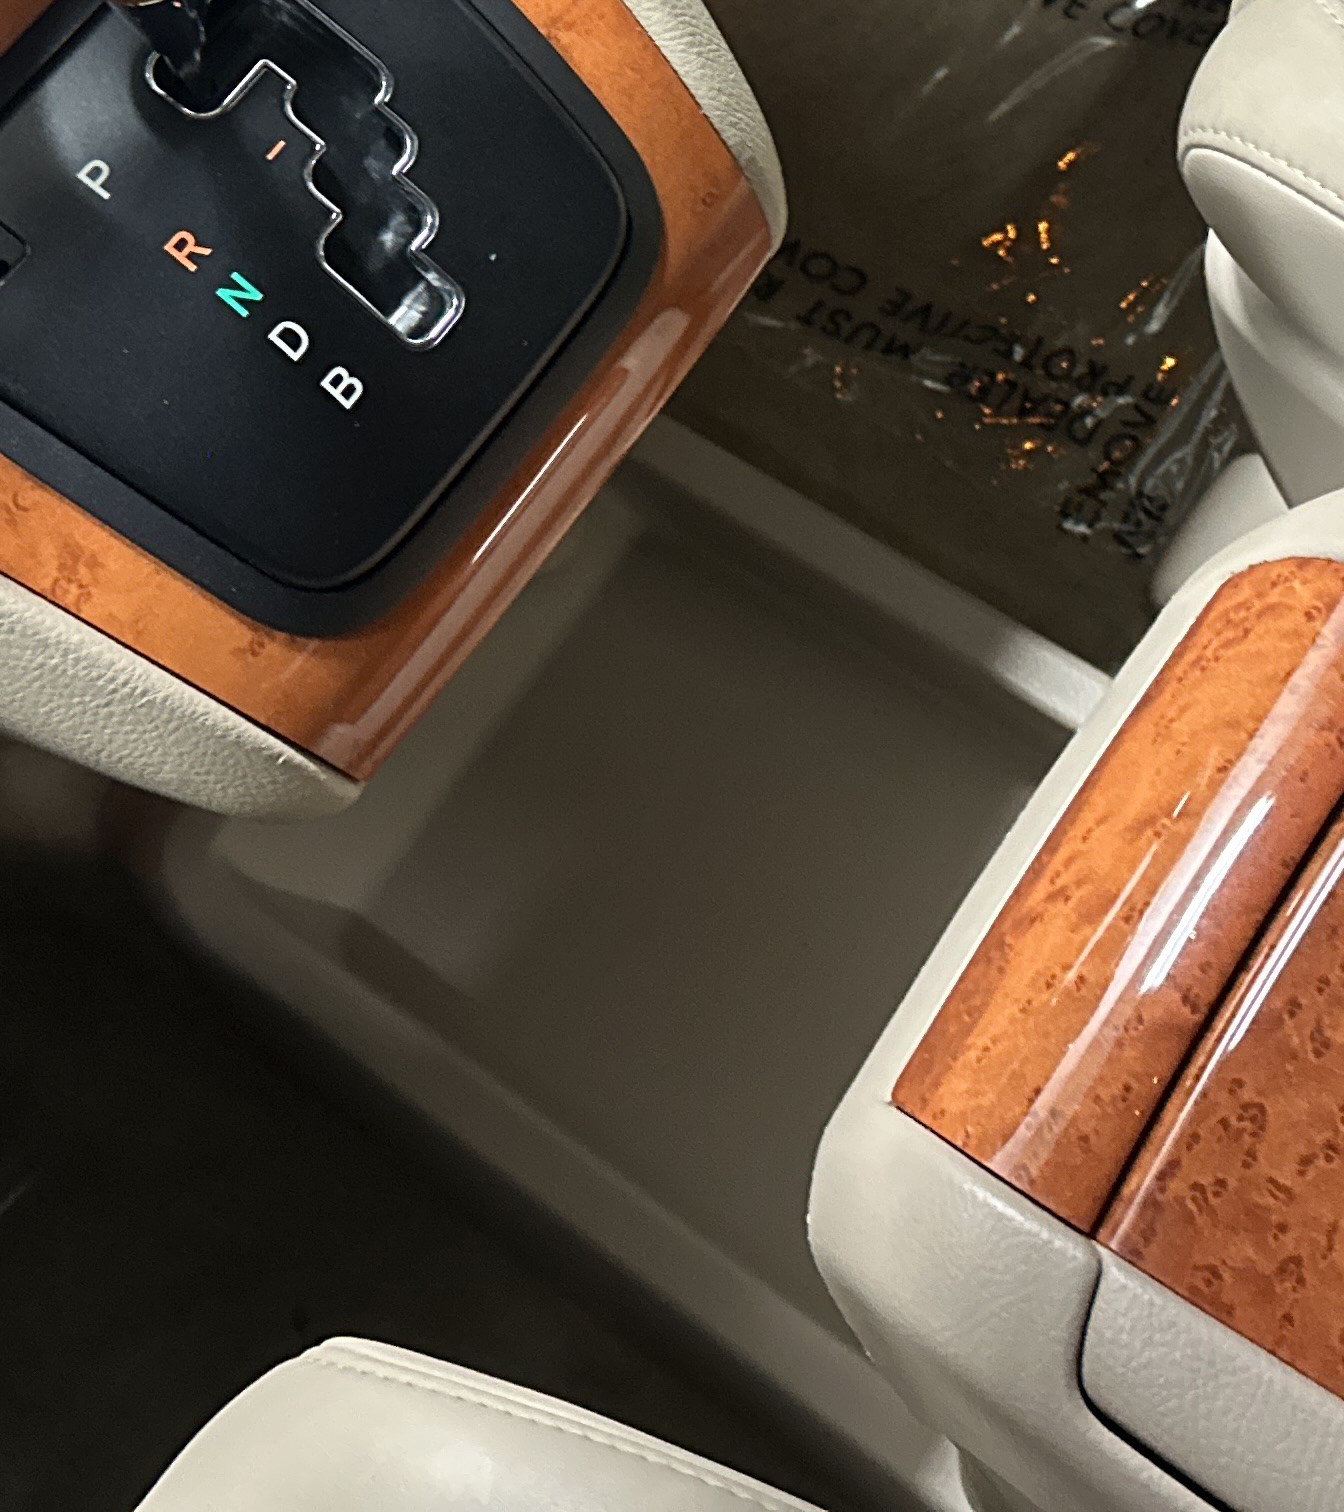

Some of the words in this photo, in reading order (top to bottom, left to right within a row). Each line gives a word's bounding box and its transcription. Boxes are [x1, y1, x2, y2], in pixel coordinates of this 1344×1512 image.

[76, 158, 112, 200] P
[163, 229, 213, 273] R
[215, 272, 264, 318] N
[267, 320, 311, 362] D
[320, 365, 365, 410] B
